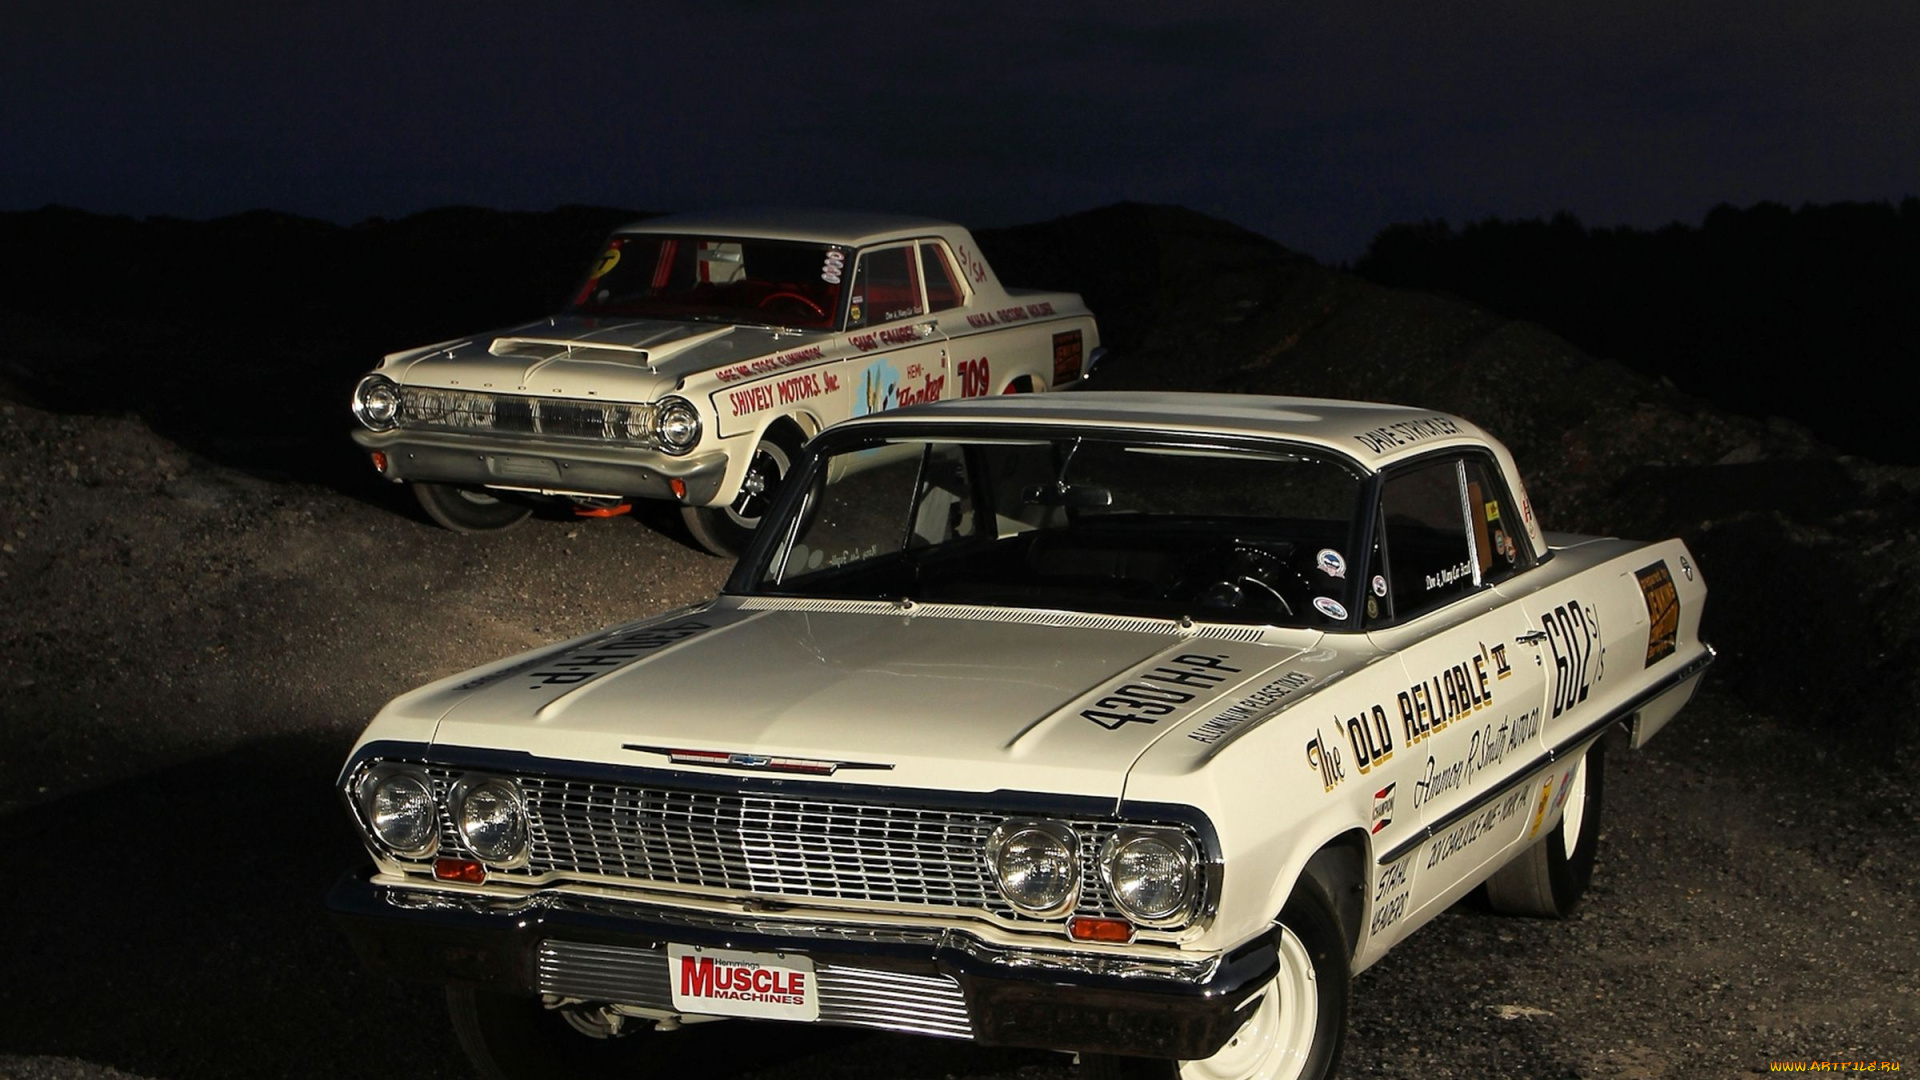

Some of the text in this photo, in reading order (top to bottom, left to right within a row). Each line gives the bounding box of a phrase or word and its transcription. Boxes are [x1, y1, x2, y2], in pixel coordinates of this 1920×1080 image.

[997, 307, 1029, 323] RECORD
[751, 359, 780, 373] STOCK
[957, 357, 990, 398] 709
[730, 384, 774, 417] SHIVELY
[1354, 417, 1465, 454] DAVE STRICKLER
[1541, 600, 1591, 719] 602
[1079, 682, 1196, 731] 430
[1188, 704, 1255, 745] ALUMINUM
[1241, 682, 1291, 716] PLEASE
[1306, 728, 1345, 793] The
[1490, 643, 1512, 680] IV
[1414, 755, 1463, 808] Ammon
[1477, 714, 1508, 770] Smith
[1507, 713, 1529, 753] AUTO
[1442, 817, 1484, 861] CARLISLE
[1375, 855, 1411, 902] STAHL
[1370, 891, 1409, 938] HEADERS
[681, 955, 805, 998] MUSCLE
[715, 957, 760, 972] Hemmings
[714, 990, 805, 1006] MACHINES
